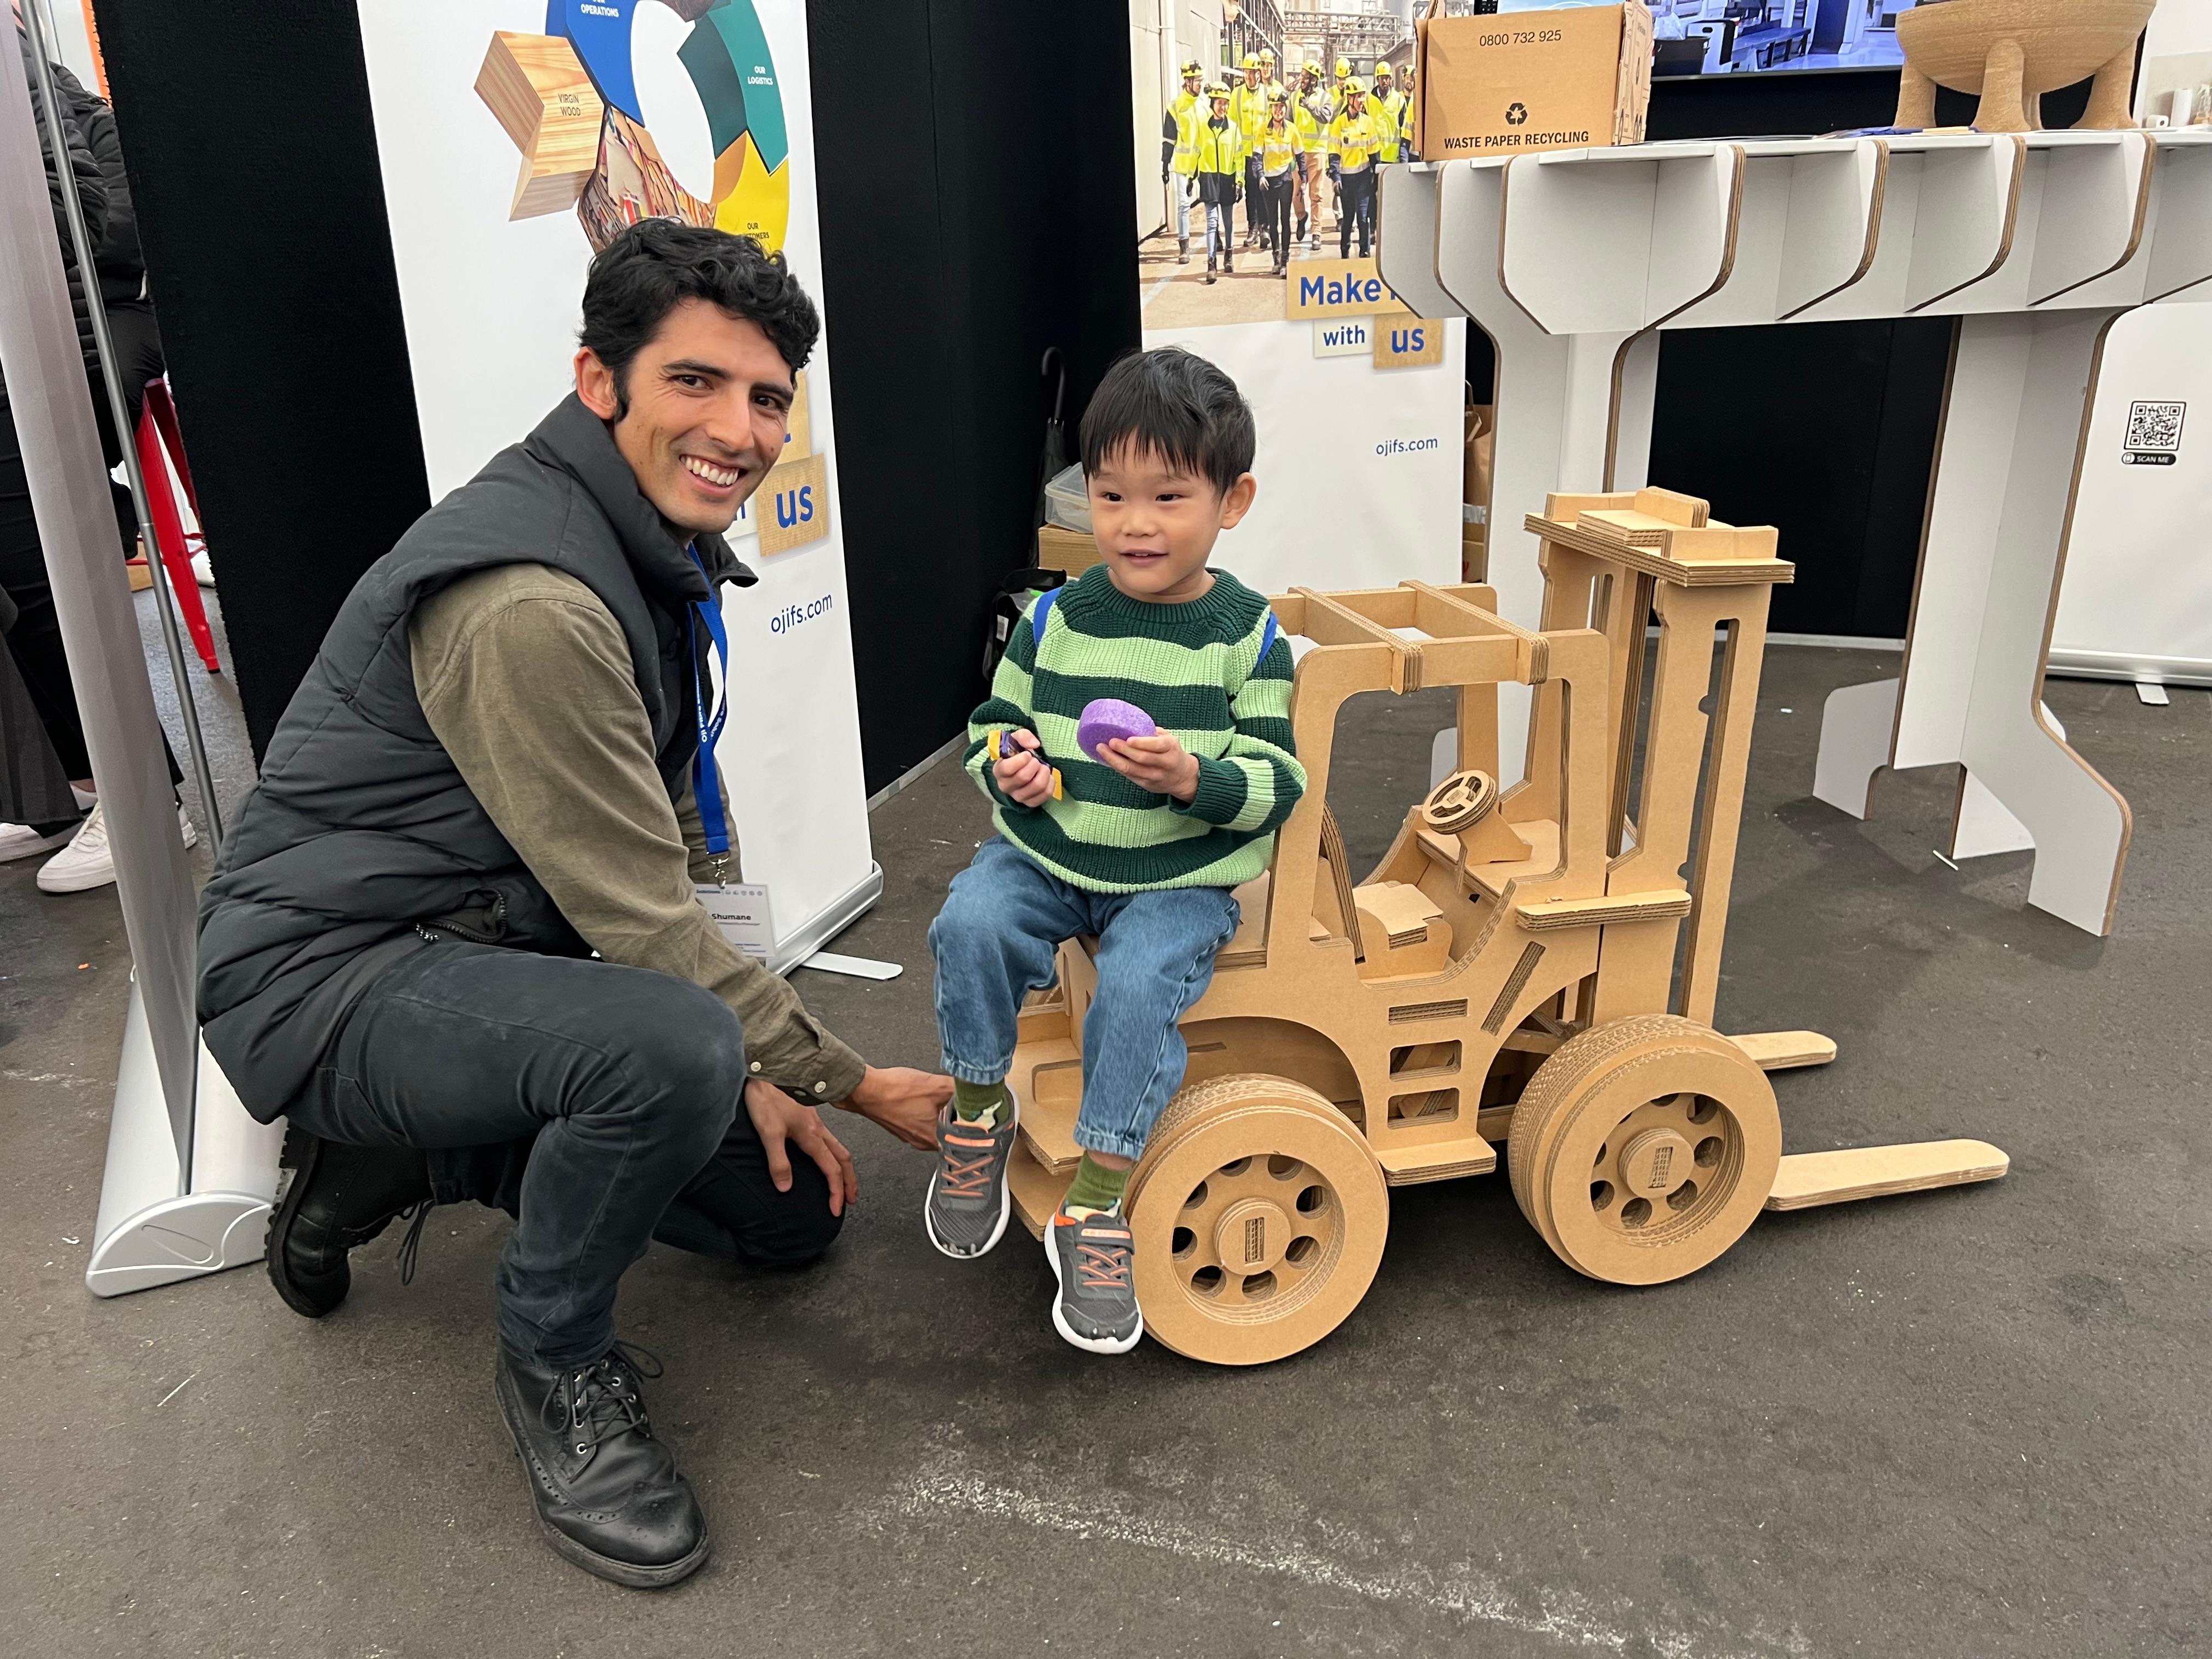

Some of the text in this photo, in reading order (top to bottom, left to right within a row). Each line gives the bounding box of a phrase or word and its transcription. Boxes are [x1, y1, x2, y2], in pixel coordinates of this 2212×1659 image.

[580, 3, 619, 18] OPERATIONS
[1479, 29, 1562, 47] 0800 732 925
[754, 65, 766, 74] OUR
[747, 76, 774, 85] LOGISTICS
[557, 93, 579, 103] VIRGIN
[560, 106, 581, 116] WOOD
[1444, 131, 1589, 149] WASTE PAPER RECYCLING
[1300, 273, 1382, 306] Make
[1323, 325, 1425, 353] with us
[1376, 438, 1438, 456] ojifs.com
[776, 486, 814, 529] us
[771, 594, 833, 634] ojifs.com
